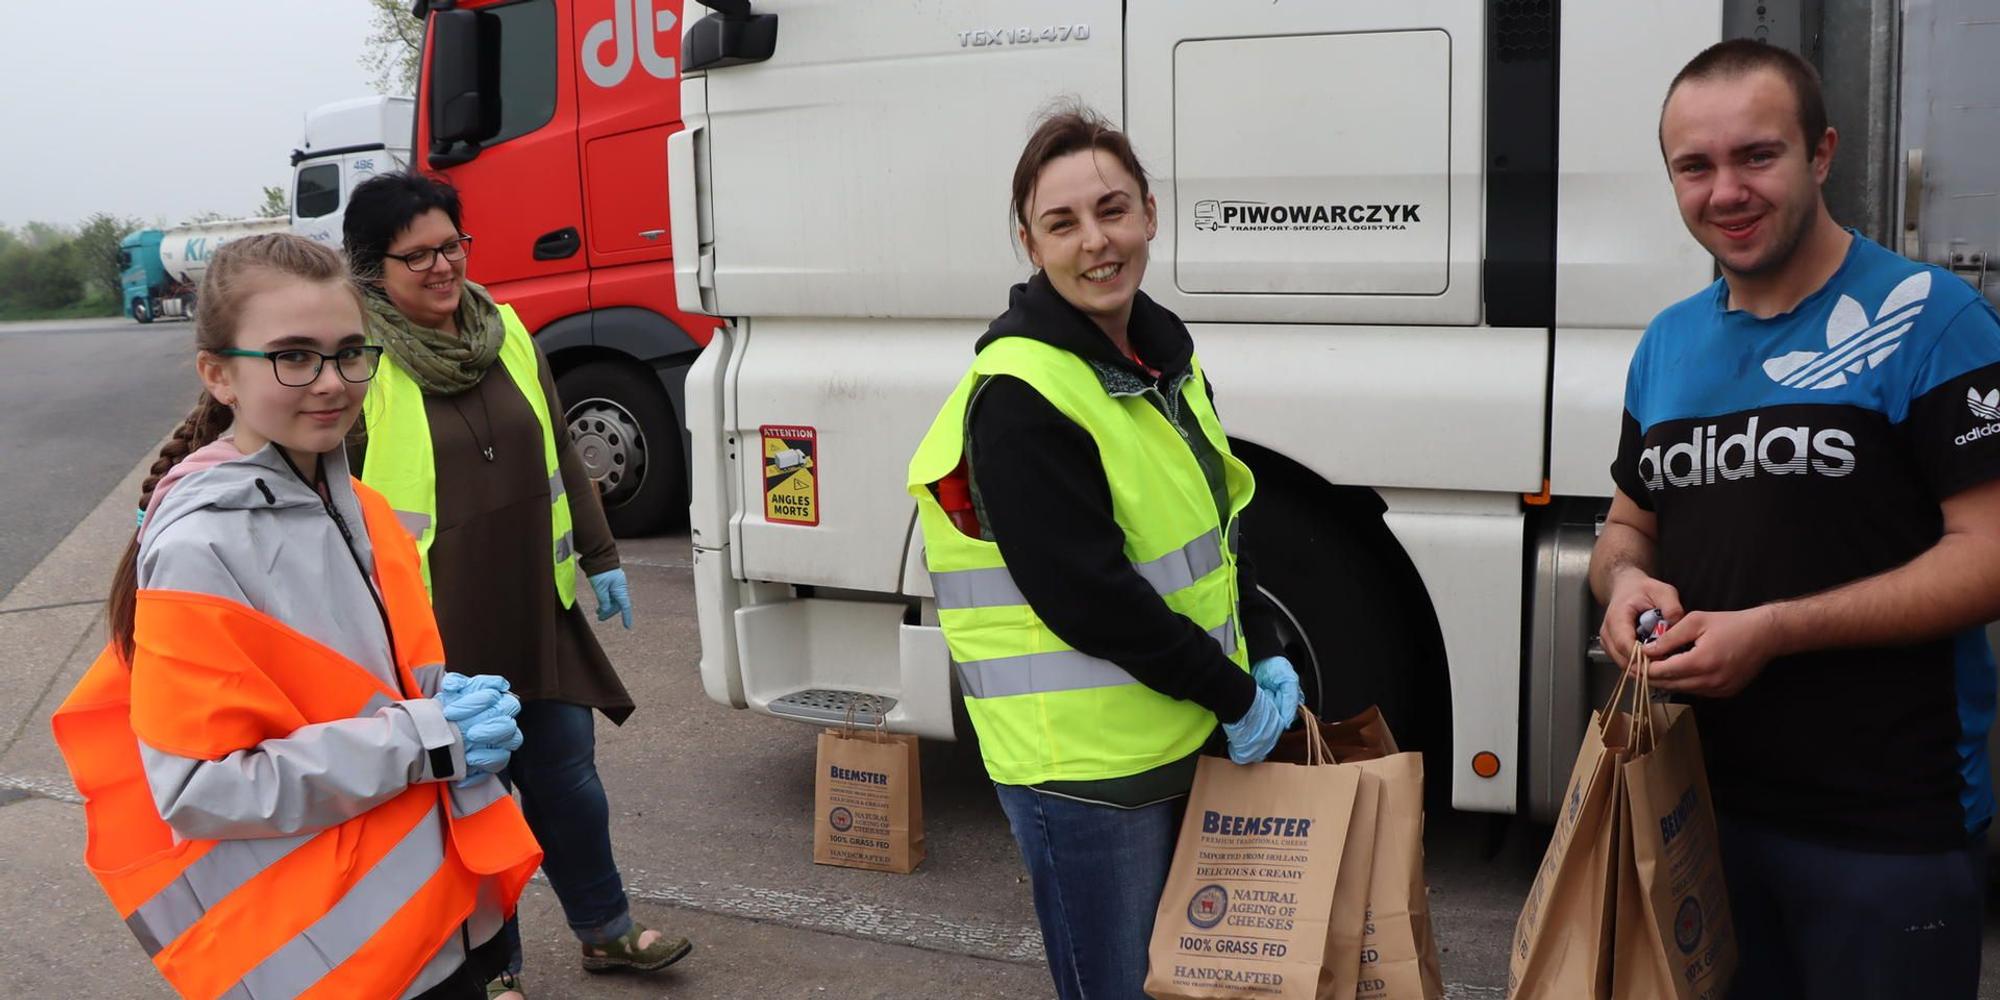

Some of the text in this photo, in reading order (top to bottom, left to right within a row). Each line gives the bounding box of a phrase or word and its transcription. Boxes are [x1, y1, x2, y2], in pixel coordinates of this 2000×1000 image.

[1223, 205, 1421, 224] PIWOWARCZYK
[764, 429, 813, 438] ATTENTION
[1954, 423, 2000, 445] adida
[1638, 416, 1856, 491] adidas
[771, 494, 810, 506] ANGLES
[774, 505, 809, 517] MORTS
[831, 765, 888, 785] BEEMSTER
[1202, 810, 1311, 837] BEEMSTER
[1259, 868, 1306, 879] CREAMY
[1232, 889, 1298, 904] NATURAL
[1228, 903, 1297, 917] AGEING OF
[1227, 914, 1294, 931] CHEESES
[1179, 936, 1287, 957] 100% GRASS FED
[1174, 965, 1283, 986] HANDCRAFTED
